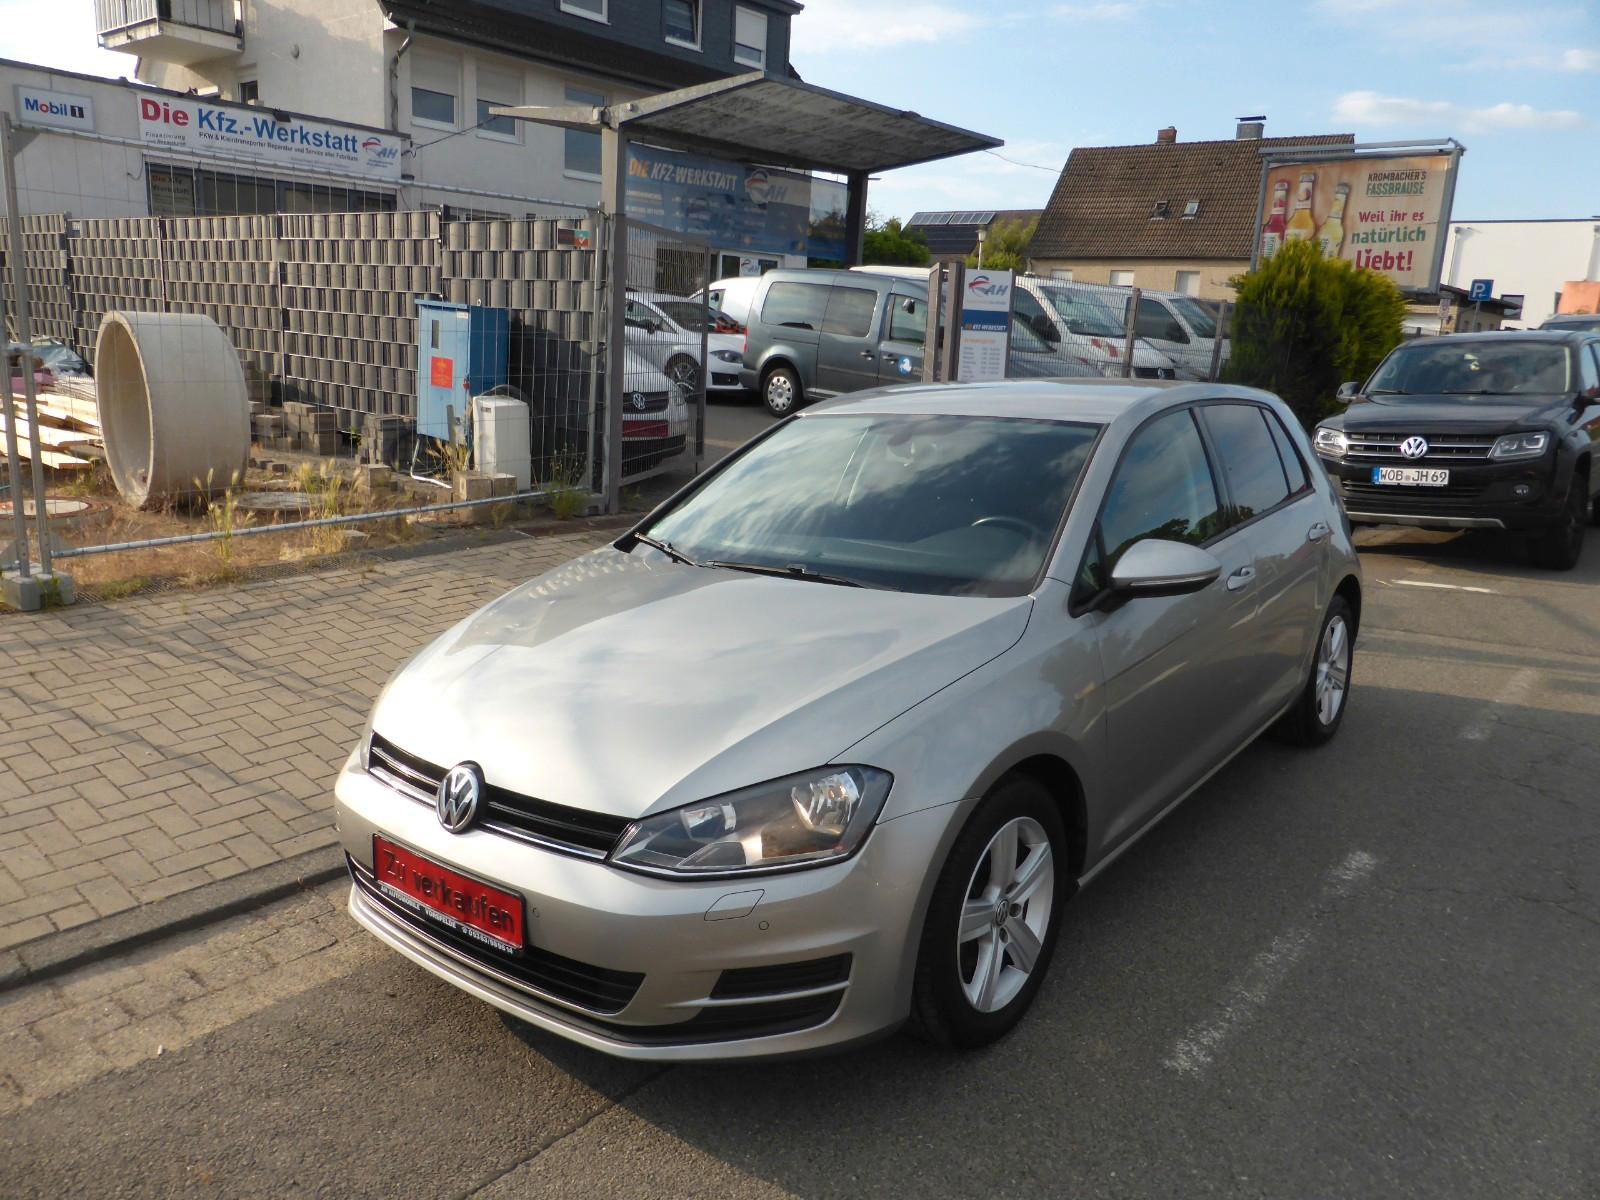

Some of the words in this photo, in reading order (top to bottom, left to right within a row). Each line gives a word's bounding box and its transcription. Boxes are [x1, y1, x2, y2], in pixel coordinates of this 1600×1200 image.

[24, 97, 68, 116] Mobil
[71, 105, 84, 118] 1
[141, 98, 189, 126] Die
[198, 108, 358, 153] Kfz.-Werkstatt
[199, 132, 214, 140] PKW
[379, 147, 398, 159] AH
[651, 161, 738, 191] KFZ-WERKSTATT
[1368, 171, 1427, 182] KROMBACHER'S
[1366, 182, 1425, 195] FASSBRAUSE
[1359, 210, 1385, 223] Weil
[1390, 209, 1408, 222] ihr
[1412, 211, 1425, 221] es
[1351, 226, 1426, 244] natürlich
[1356, 249, 1413, 271] liebt!
[984, 284, 1008, 297] AH
[1472, 282, 1486, 298] P
[1380, 469, 1404, 481] WOB
[1412, 470, 1429, 482] JH
[1431, 471, 1447, 482] 69
[383, 848, 407, 882] Zu
[412, 869, 515, 934] verkaufen
